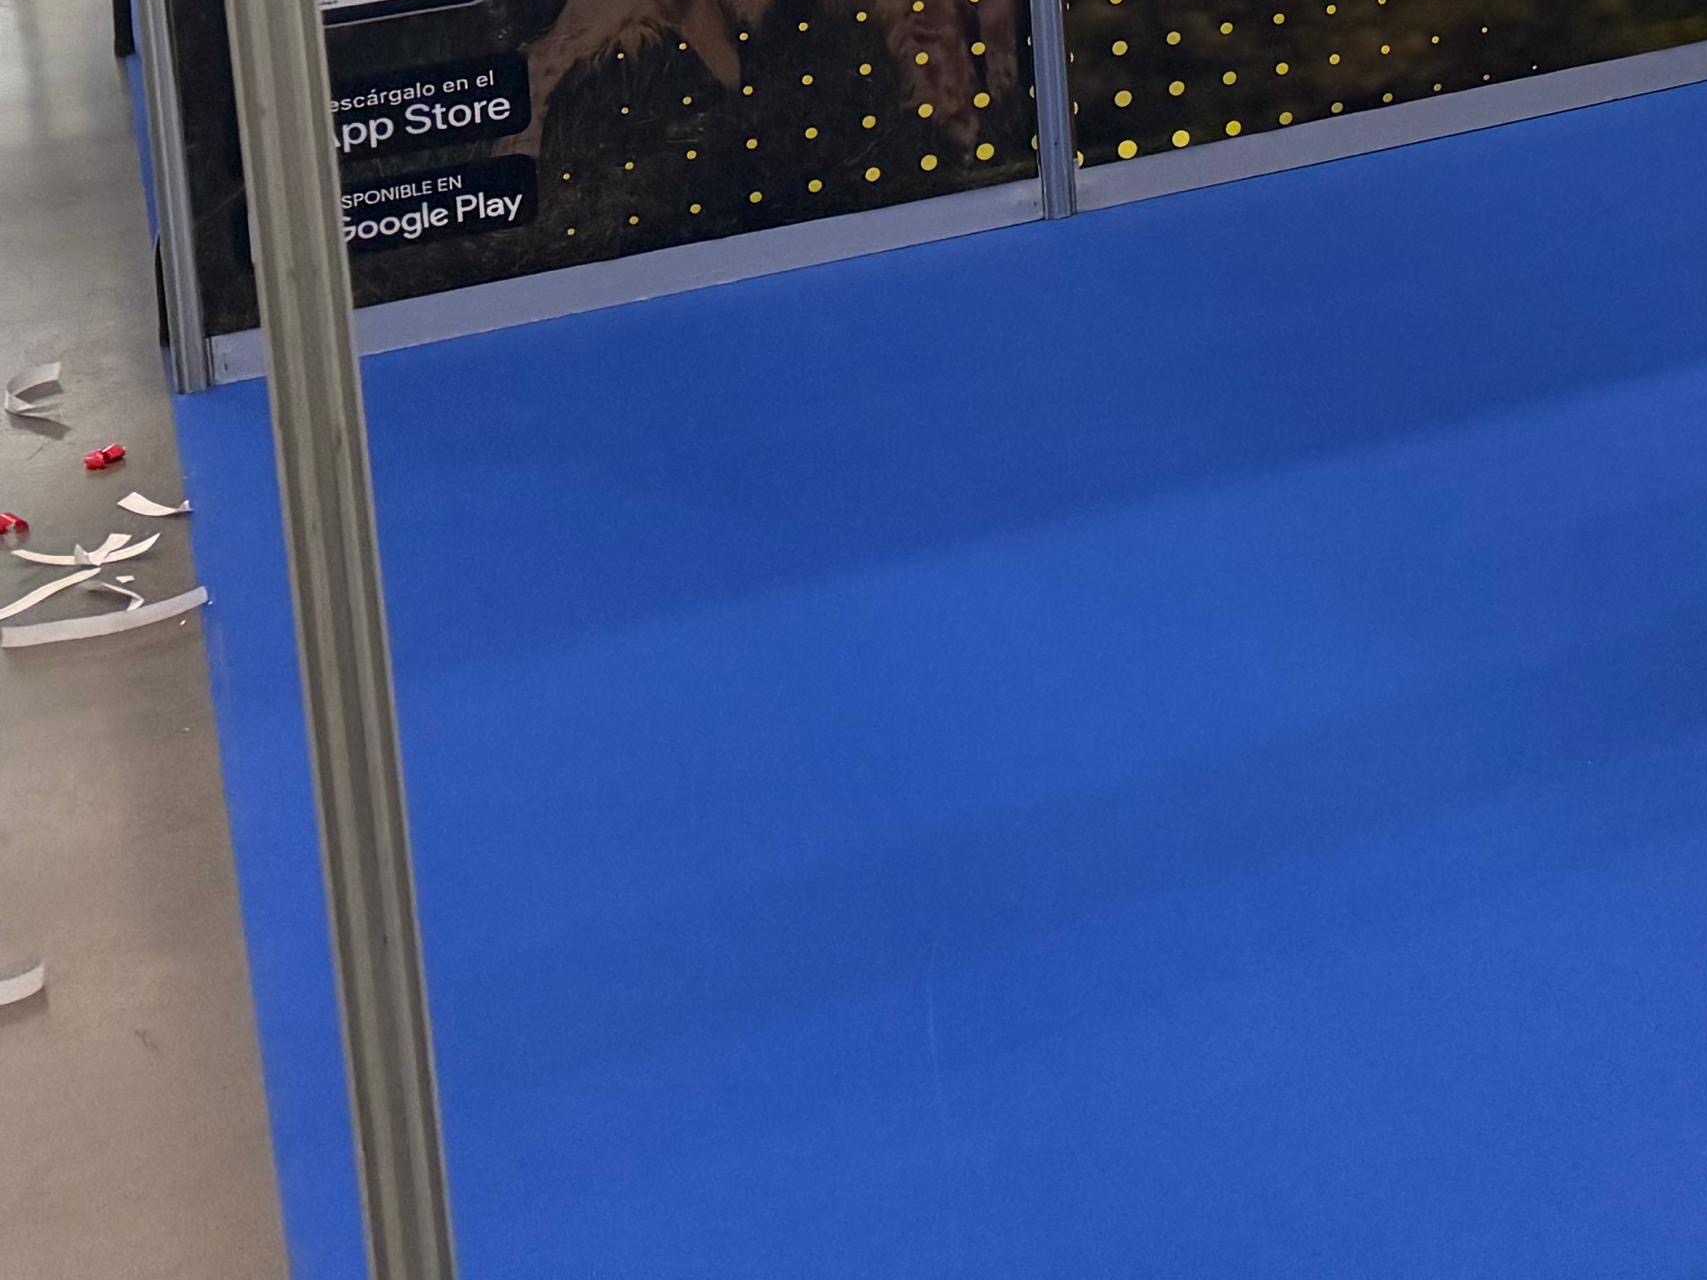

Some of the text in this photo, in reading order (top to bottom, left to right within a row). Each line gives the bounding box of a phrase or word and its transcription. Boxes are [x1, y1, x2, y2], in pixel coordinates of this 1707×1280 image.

[329, 69, 495, 113] escárgalo en el
[404, 96, 512, 135] Store
[341, 174, 464, 210] SPONIBLE EN
[455, 192, 524, 222] Play
